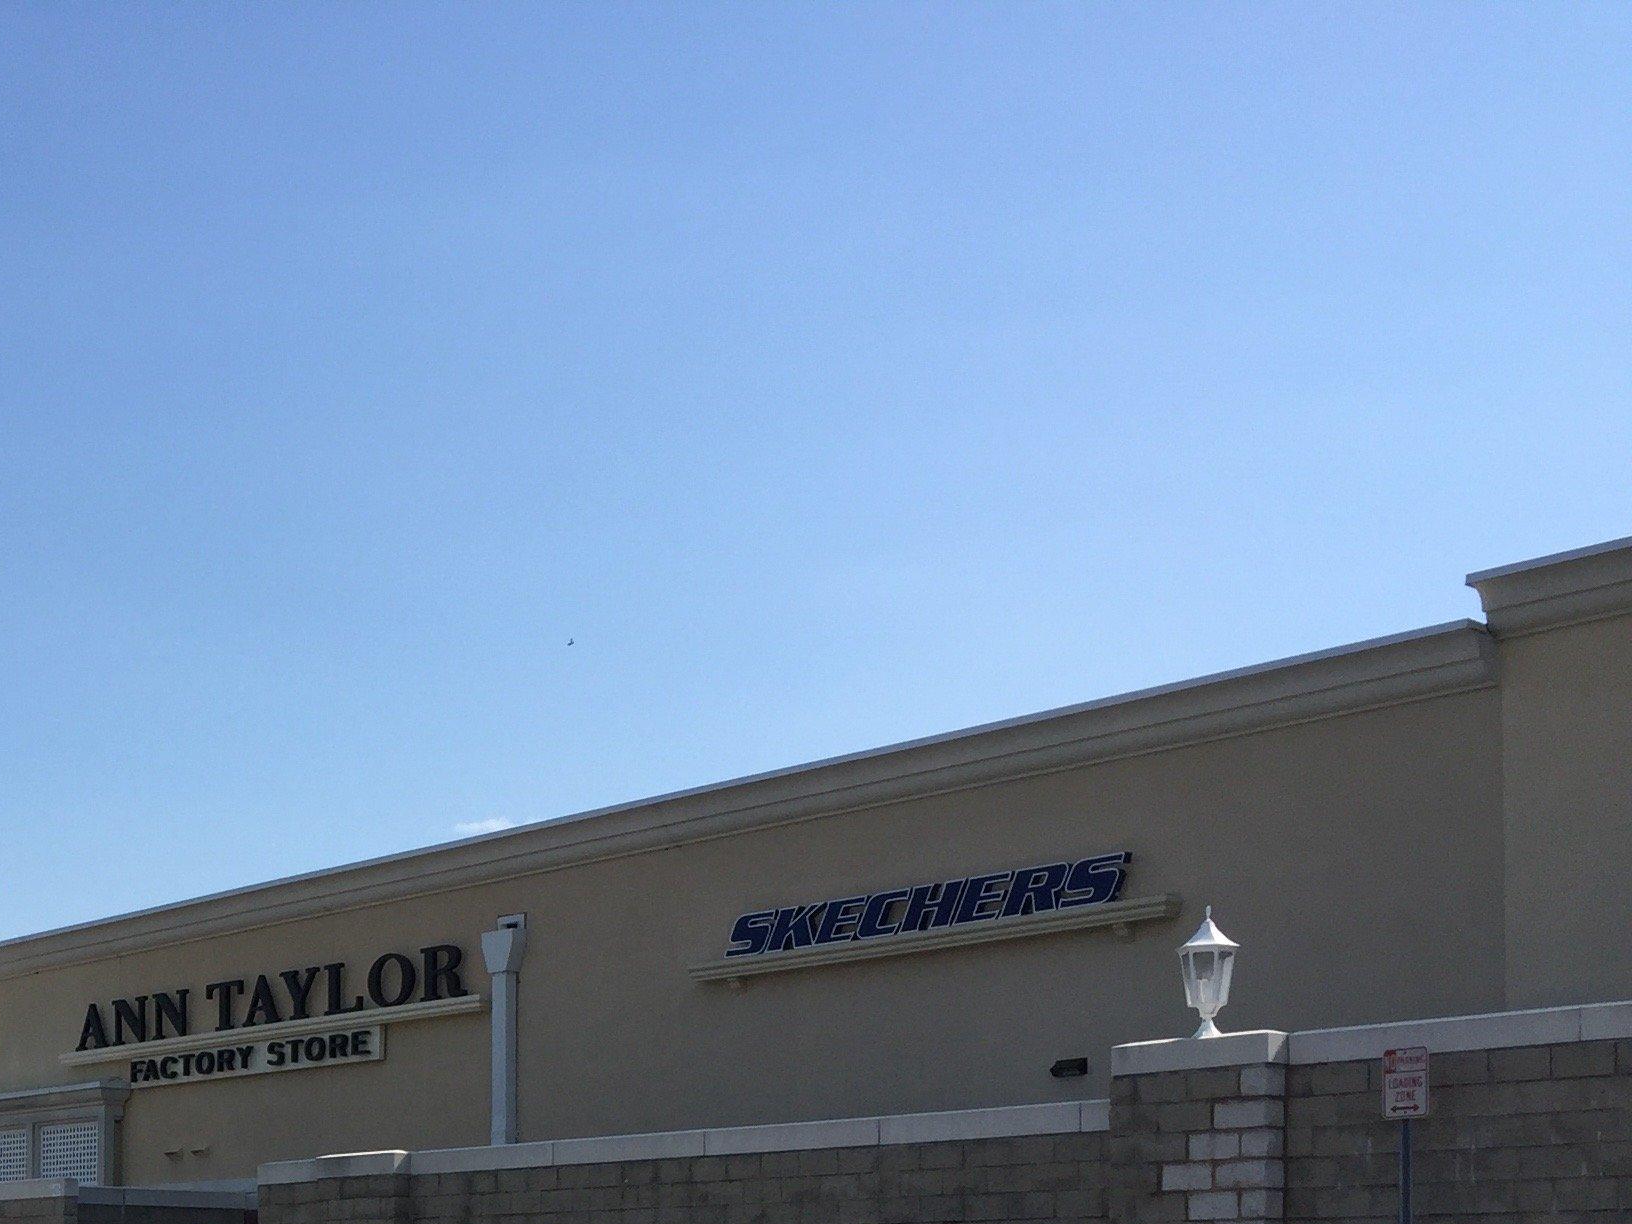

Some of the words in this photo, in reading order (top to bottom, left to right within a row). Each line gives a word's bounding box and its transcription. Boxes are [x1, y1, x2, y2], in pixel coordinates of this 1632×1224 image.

[724, 851, 1133, 958] SKECHERS
[75, 989, 190, 1052] ANN
[206, 943, 467, 1032] TAYLOR
[130, 1046, 254, 1083] FACTORY
[267, 1030, 372, 1066] STORE
[1395, 1090, 1416, 1102] ZONE
